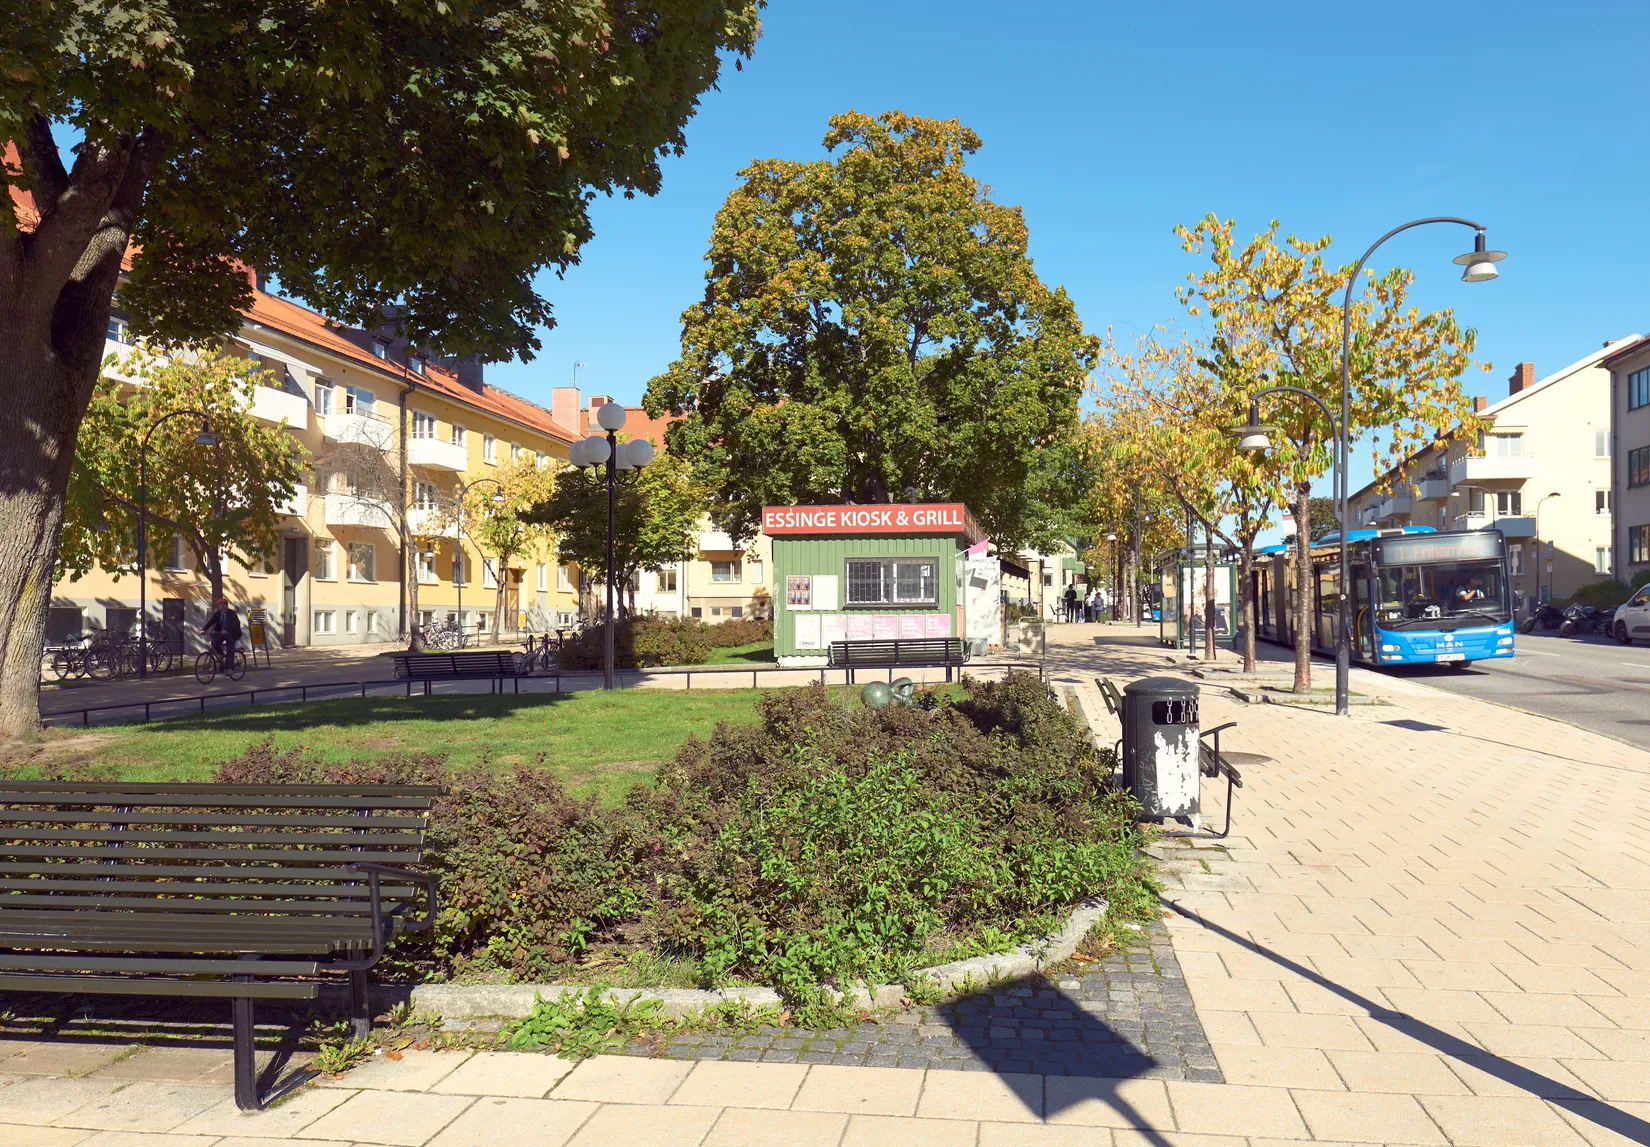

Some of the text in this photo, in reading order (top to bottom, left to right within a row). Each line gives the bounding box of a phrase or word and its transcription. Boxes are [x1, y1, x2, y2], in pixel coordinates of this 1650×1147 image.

[766, 509, 962, 528] ESSINGE KIOSK & GRILL
